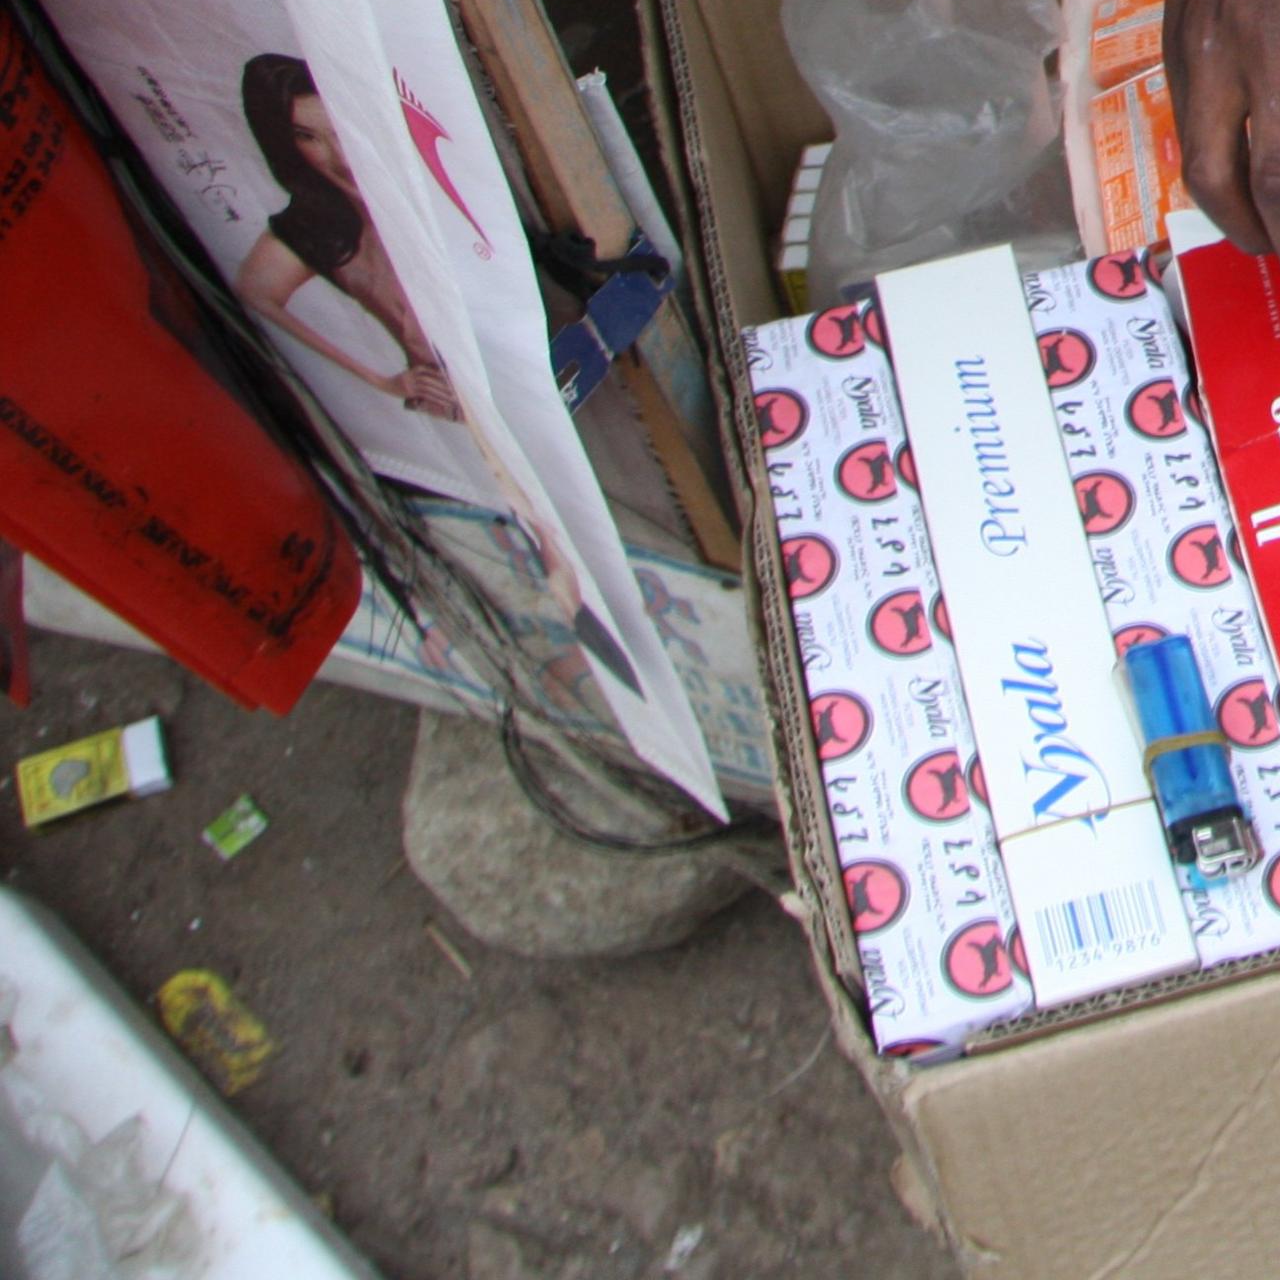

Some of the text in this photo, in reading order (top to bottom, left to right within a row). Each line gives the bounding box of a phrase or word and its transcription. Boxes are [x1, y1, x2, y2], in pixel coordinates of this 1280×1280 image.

[1127, 316, 1166, 369] Nyala
[841, 374, 881, 430] Nyala
[954, 354, 1028, 558] Premium
[1211, 604, 1255, 667] Nyala
[908, 673, 951, 738] Nyala
[1001, 635, 1113, 839] Nyala
[1055, 933, 1162, 974] 1234 9876
